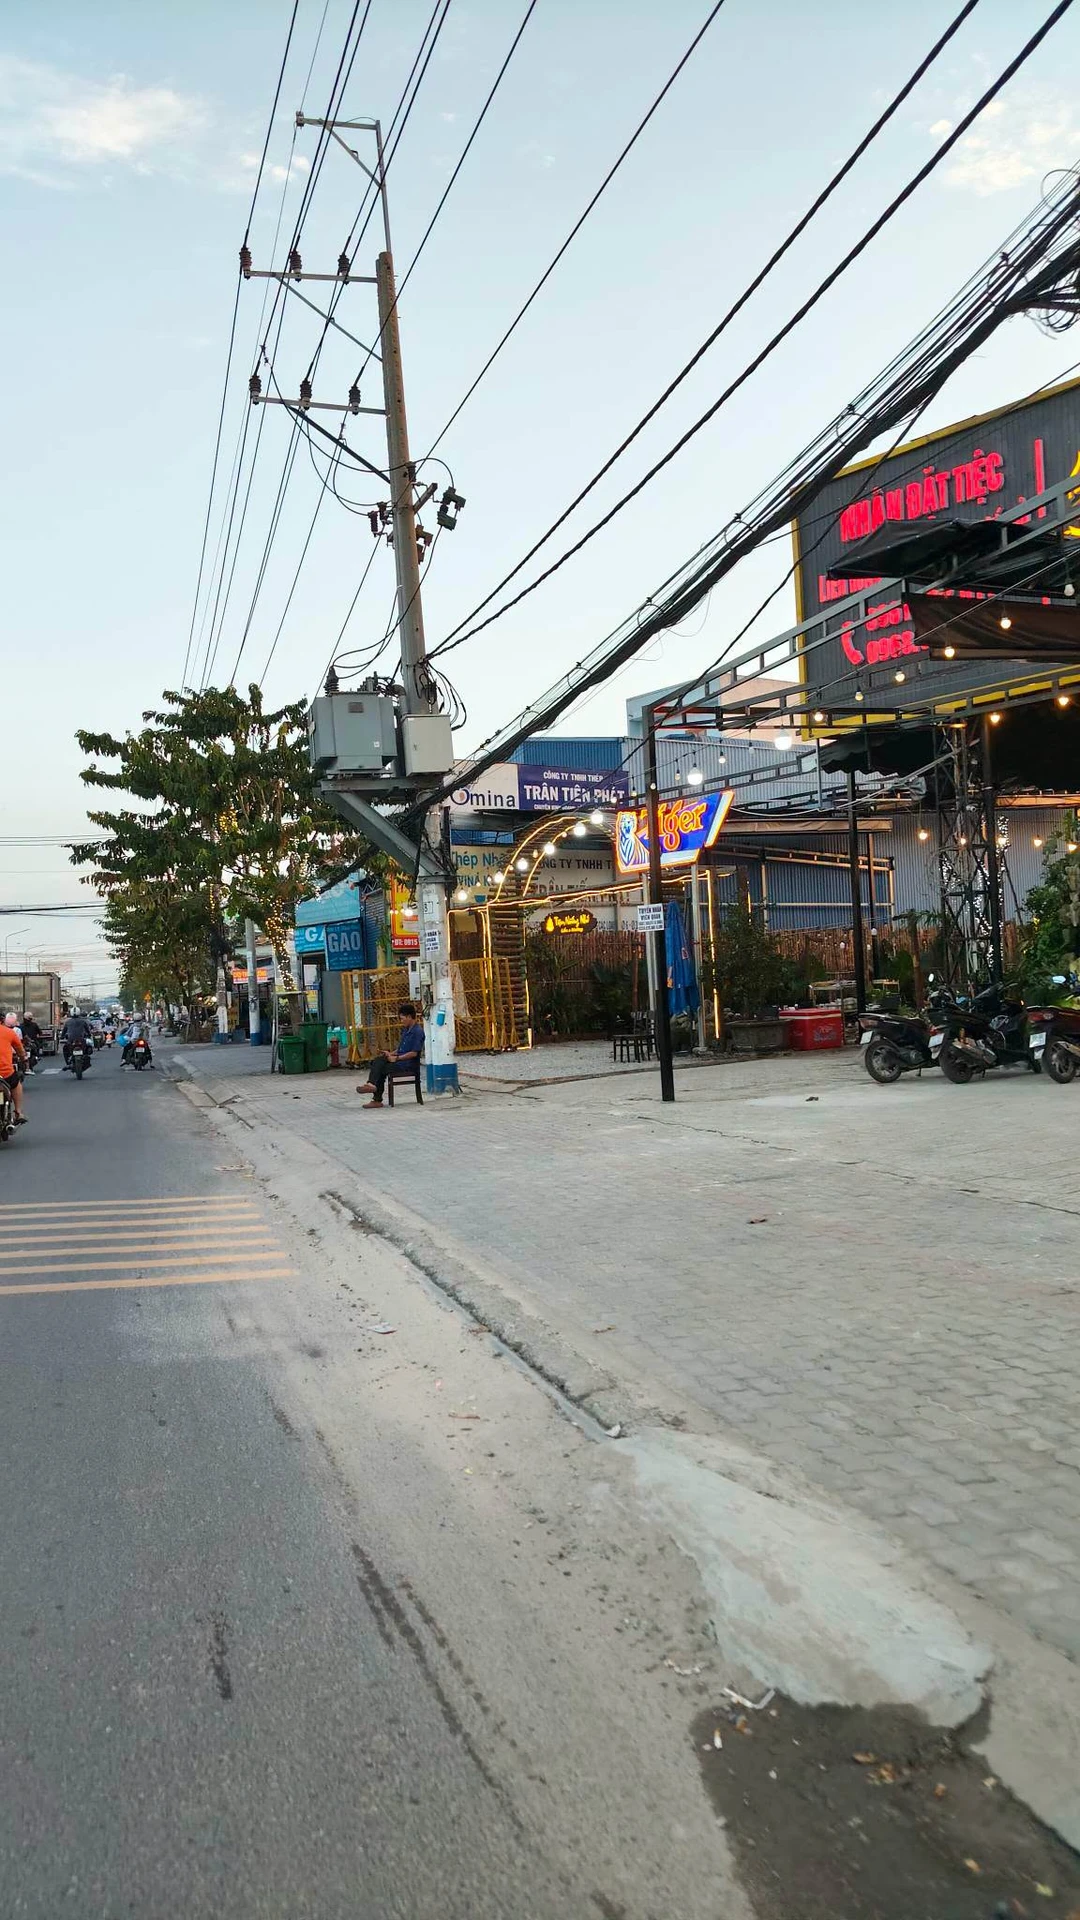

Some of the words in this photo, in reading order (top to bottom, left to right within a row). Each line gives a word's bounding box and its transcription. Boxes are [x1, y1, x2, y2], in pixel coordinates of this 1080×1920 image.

[905, 465, 950, 520] ĐẶT
[951, 448, 1005, 506] TIỆC
[543, 770, 560, 780] CÔNG
[560, 772, 569, 780] TY
[570, 773, 587, 782] TNHH
[587, 773, 604, 783] THÉP
[450, 787, 516, 808] Omina
[558, 859, 572, 869] TY
[575, 859, 603, 870] TNHH
[305, 926, 325, 943] G
